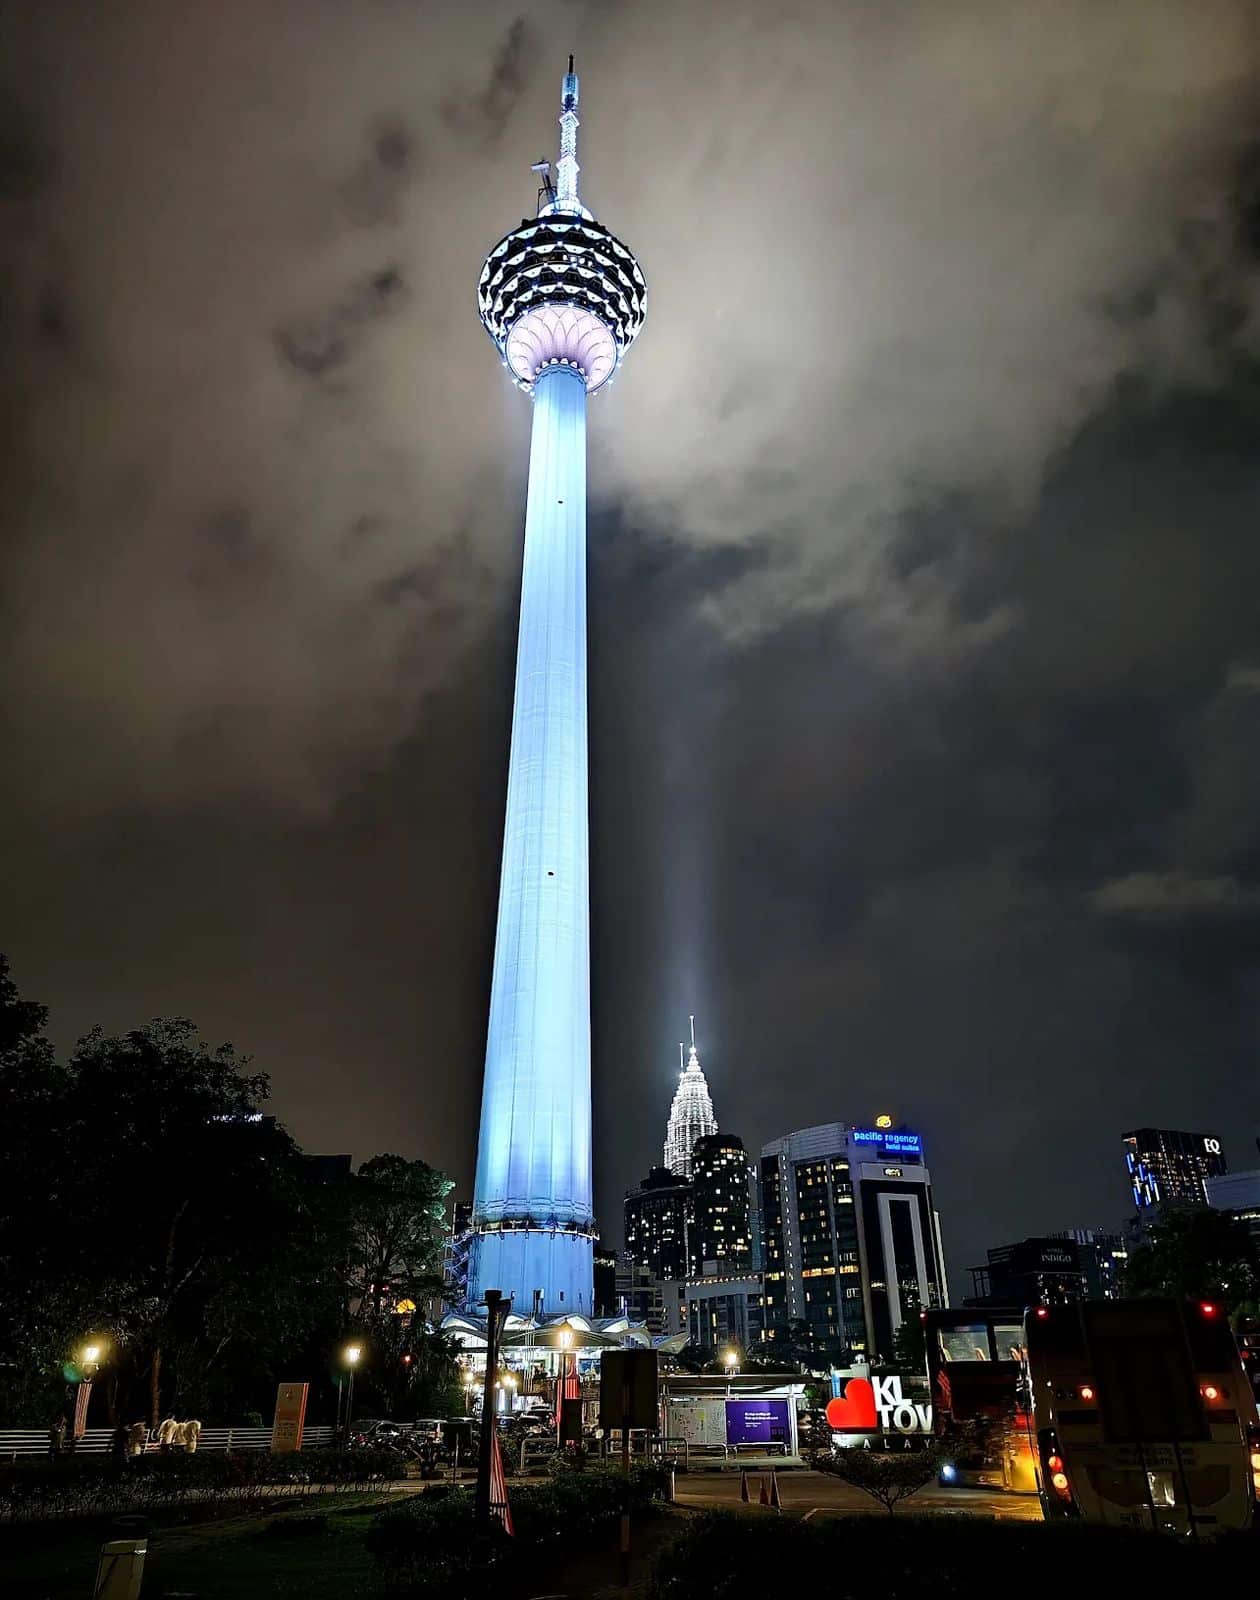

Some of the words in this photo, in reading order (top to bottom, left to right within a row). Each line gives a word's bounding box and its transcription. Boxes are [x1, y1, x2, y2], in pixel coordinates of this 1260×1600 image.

[854, 1131, 883, 1141] pacific
[884, 1134, 918, 1144] regency
[1203, 1138, 1221, 1155] EQ
[871, 1375, 912, 1406] KL
